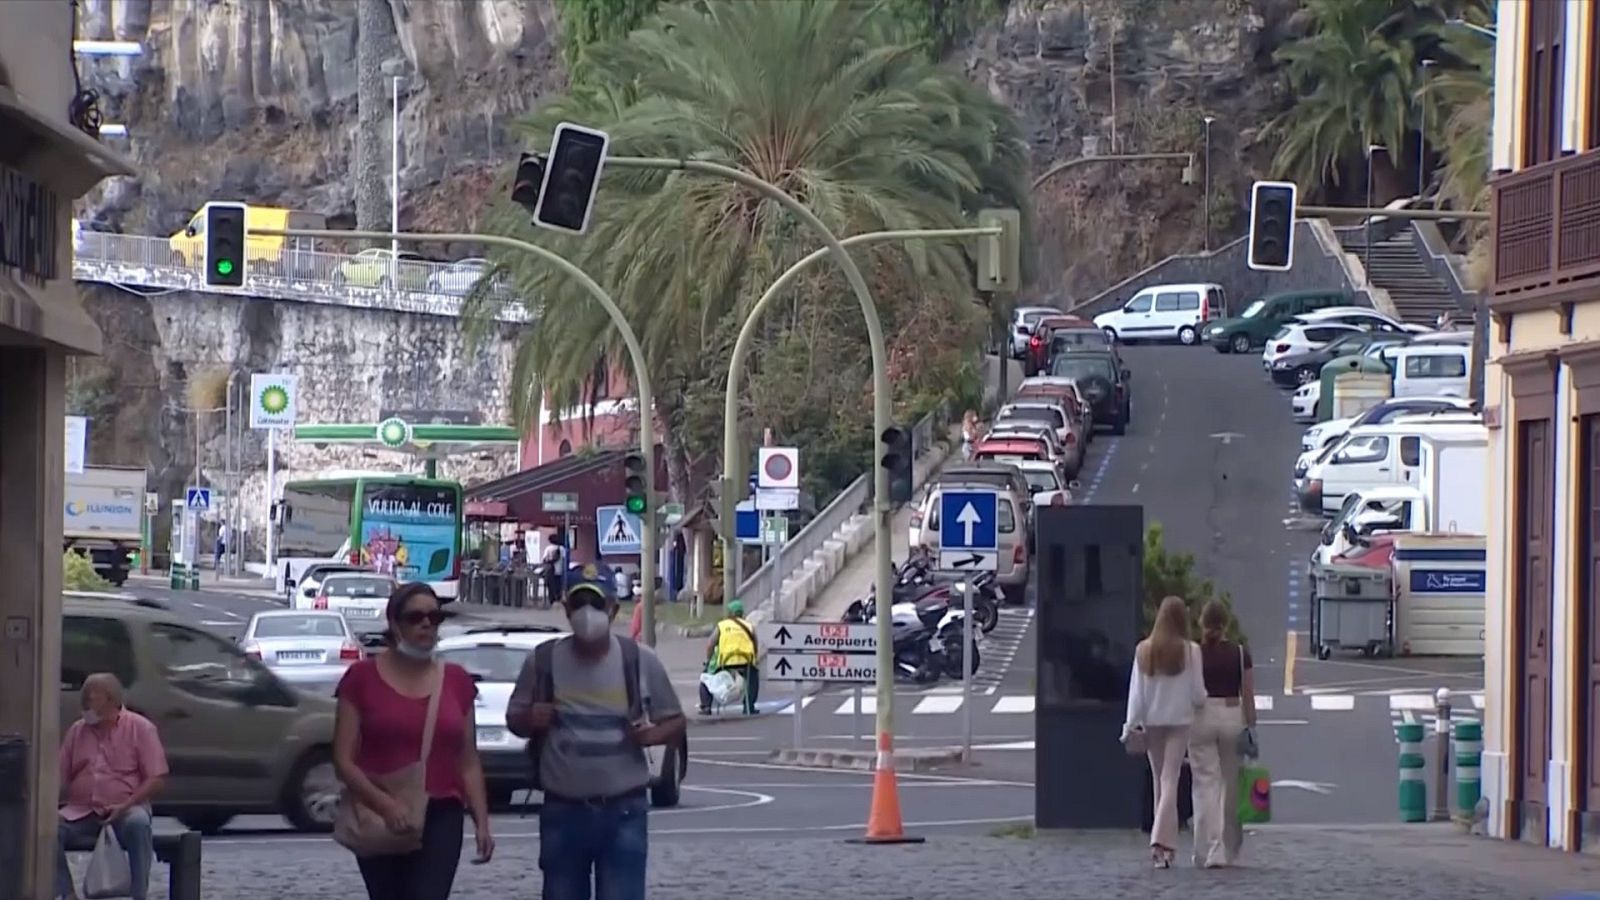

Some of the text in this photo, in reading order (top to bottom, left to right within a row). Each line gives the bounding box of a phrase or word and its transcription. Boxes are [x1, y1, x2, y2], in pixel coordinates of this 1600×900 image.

[368, 499, 452, 518] VUELTA AL COLE
[804, 635, 876, 649] Aeropuert
[802, 666, 826, 678] LOS
